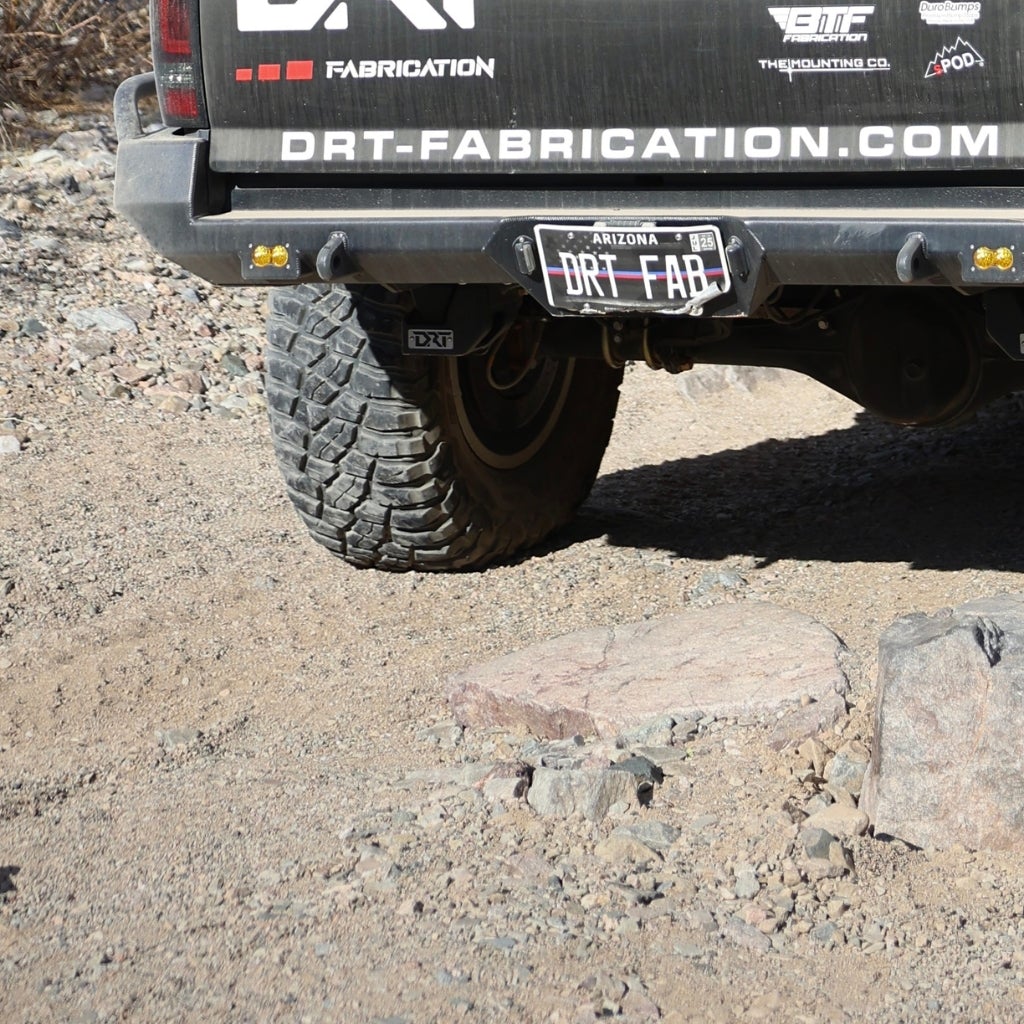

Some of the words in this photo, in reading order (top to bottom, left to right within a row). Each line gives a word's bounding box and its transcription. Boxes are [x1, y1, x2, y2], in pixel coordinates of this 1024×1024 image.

[920, 2, 980, 12] DuroBumps
[784, 6, 875, 34] BTF
[783, 33, 868, 43] FABRICATION
[325, 56, 495, 79] FABRICATION
[758, 59, 788, 69] THE
[791, 58, 863, 68] MOUNTING
[867, 58, 890, 67] CO.
[281, 126, 998, 162] DRT-FABRICATION.COM
[592, 233, 659, 245] ARIZONA
[700, 237, 714, 248] 25
[559, 252, 618, 298] DRT
[639, 254, 710, 300] FAB
[413, 330, 452, 347] DRT
